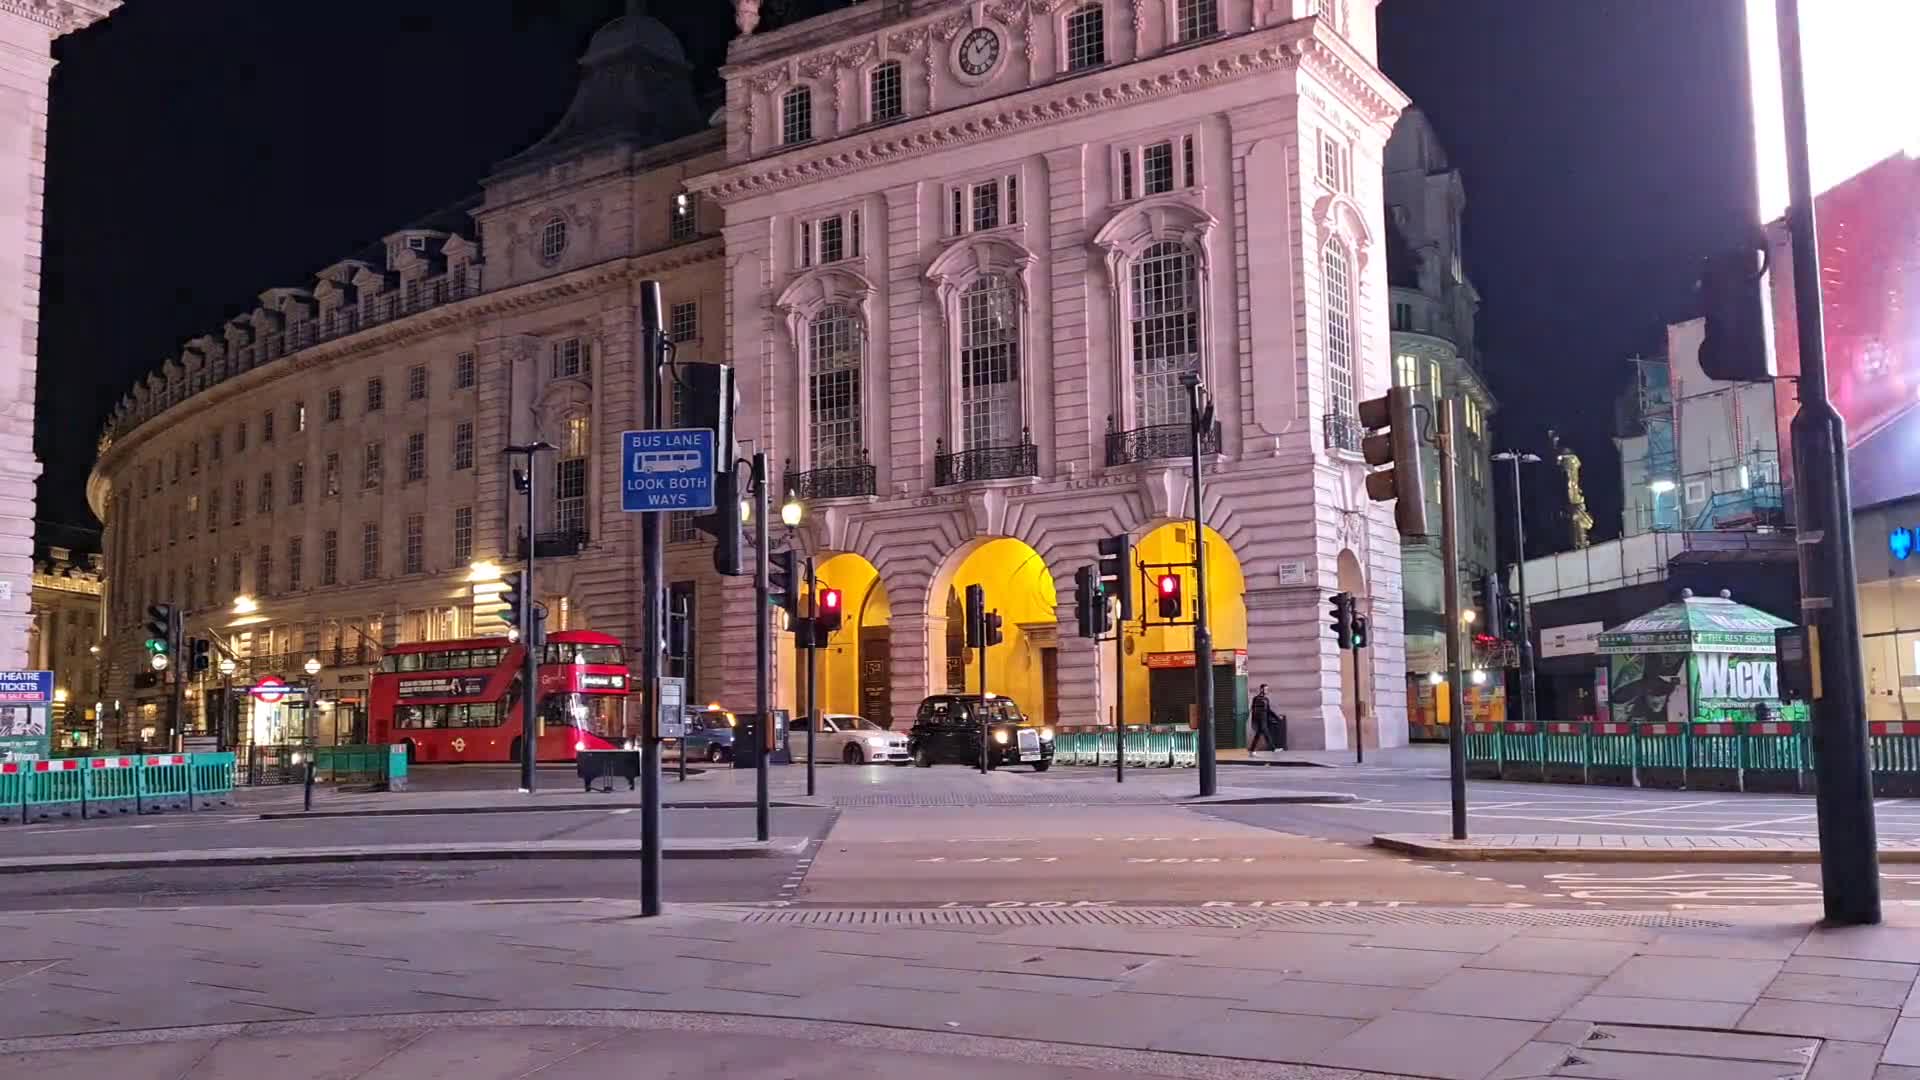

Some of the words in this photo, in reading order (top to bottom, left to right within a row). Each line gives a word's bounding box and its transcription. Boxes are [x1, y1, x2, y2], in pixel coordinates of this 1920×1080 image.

[632, 436, 661, 448] BUS
[666, 434, 702, 447] LANE
[627, 479, 664, 491] LOOK
[669, 477, 707, 489] BOTH
[648, 493, 687, 505] WAYS
[0, 672, 40, 681] THEATRE
[1697, 653, 1779, 699] WICK
[0, 682, 38, 691] TICKETS
[938, 900, 1117, 908] LOOK
[1201, 900, 1418, 908] RIGHT
